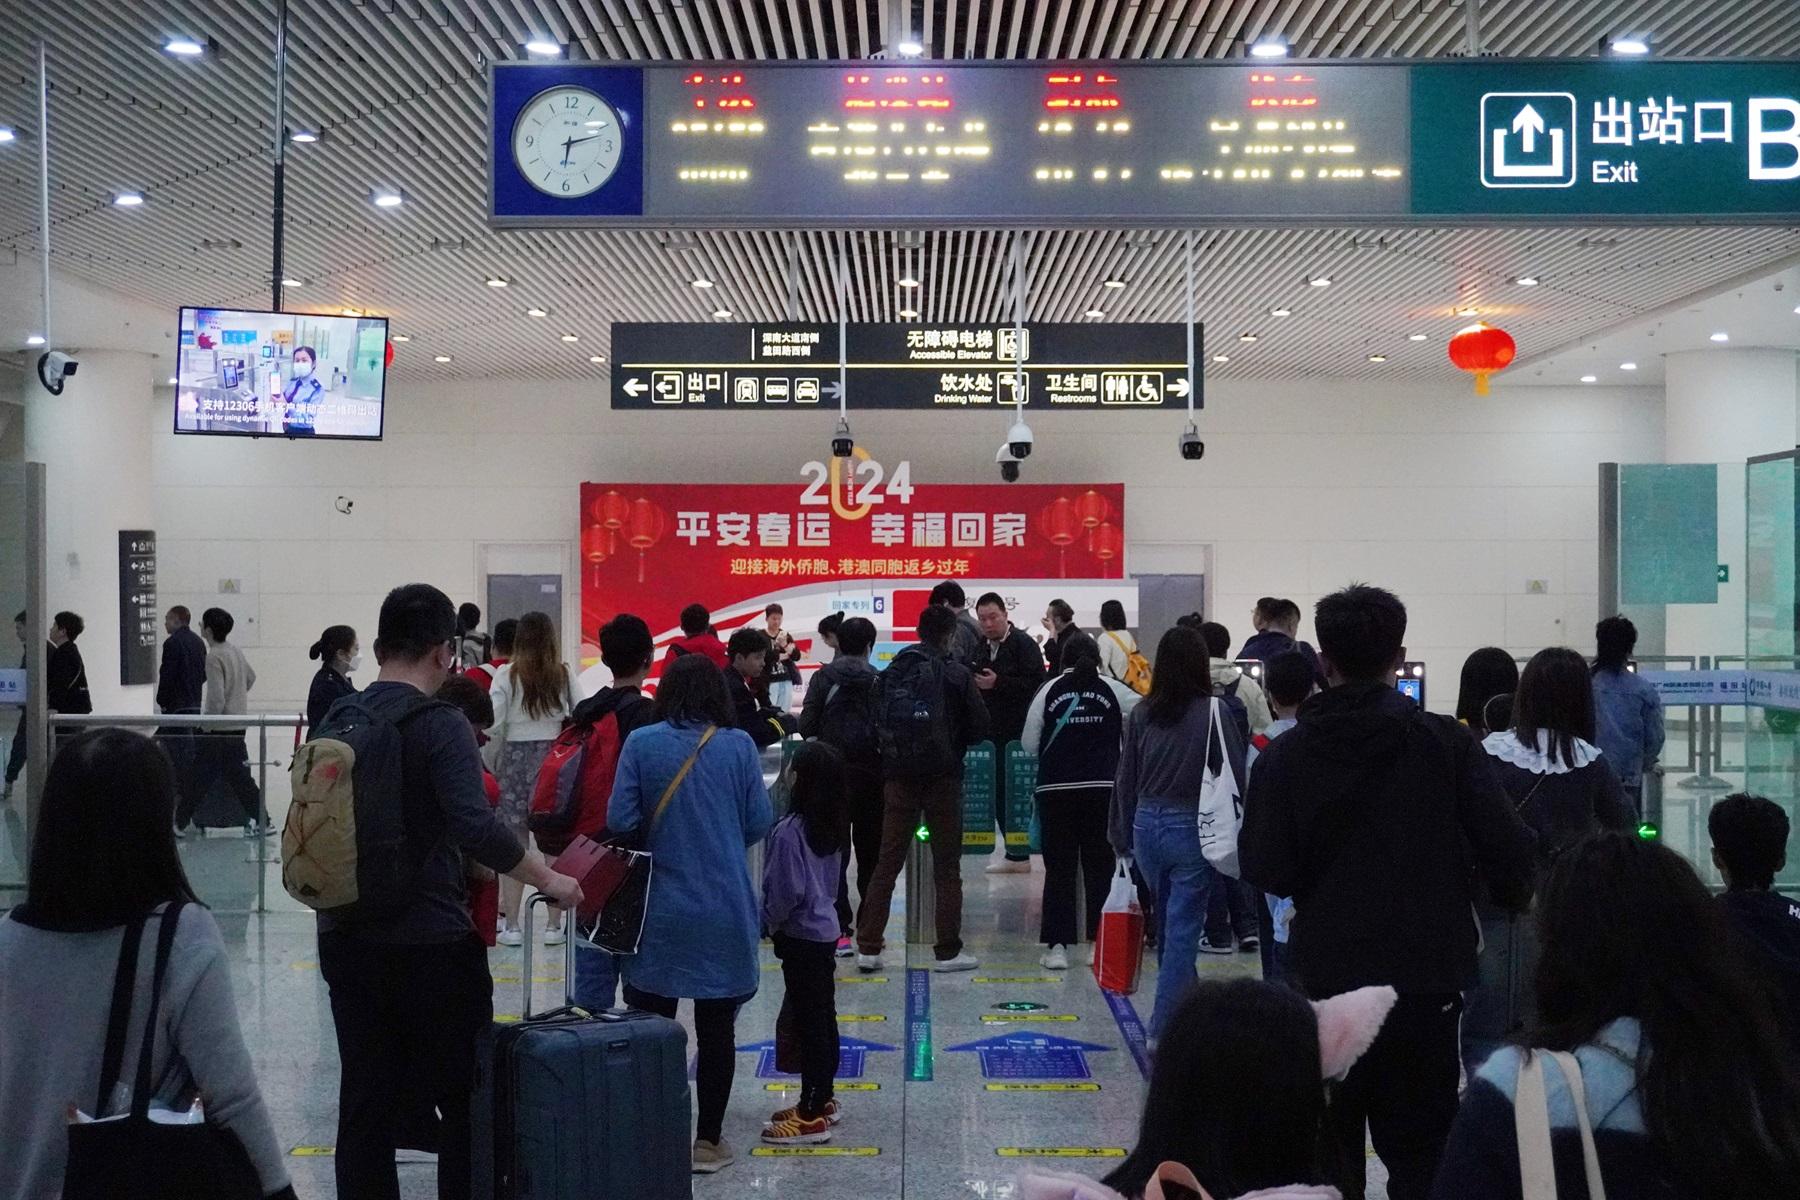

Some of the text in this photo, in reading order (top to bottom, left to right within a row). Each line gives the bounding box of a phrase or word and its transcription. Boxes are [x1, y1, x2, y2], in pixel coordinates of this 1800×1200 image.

[565, 97, 579, 108] 12
[1592, 96, 1732, 146] 出站口
[525, 135, 534, 147] 9
[604, 140, 613, 152] 3
[1748, 98, 1800, 180] B
[1592, 161, 1638, 183] Exit
[562, 181, 570, 191] 6
[907, 329, 993, 348] 无障碍电梯
[910, 350, 993, 360] Accessible Elevator
[687, 372, 721, 392] 出口
[940, 373, 993, 392] 饮水处
[1045, 374, 1098, 393] 卫生间
[687, 393, 706, 403] Exit
[934, 394, 993, 405] Drinking Water
[1050, 394, 1097, 404] Restrooms
[676, 511, 1026, 547] 平安春运 幸福回家
[730, 558, 970, 576] 迎接海外侨胞、港澳同胞返乡过年
[832, 599, 884, 611] 回家专列 6
